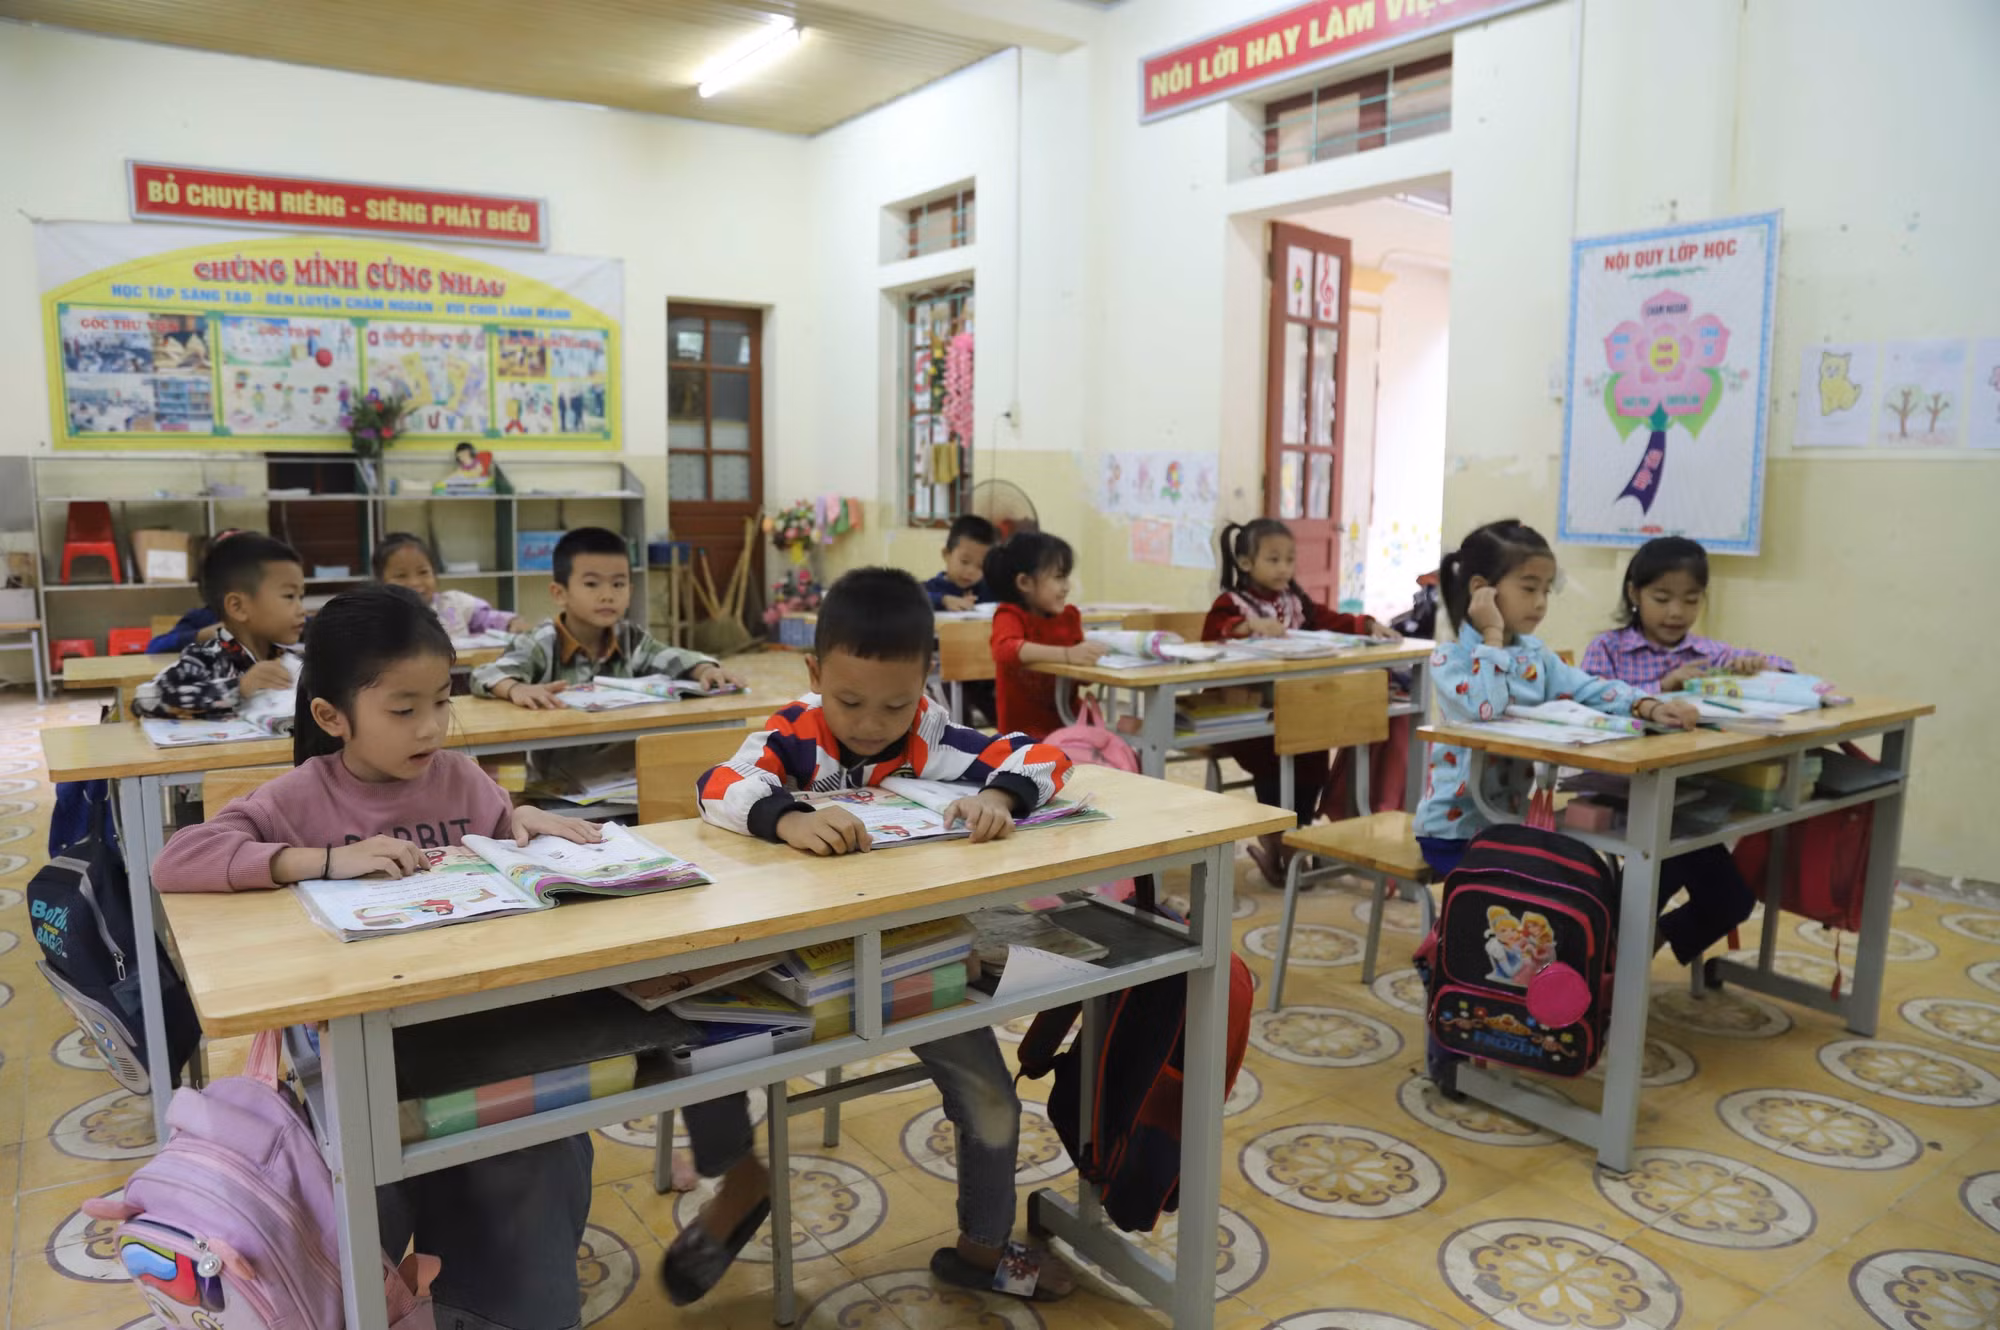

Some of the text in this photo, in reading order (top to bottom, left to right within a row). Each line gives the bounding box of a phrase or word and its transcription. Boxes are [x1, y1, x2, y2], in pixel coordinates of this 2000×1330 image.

[1150, 0, 1456, 99] NÓI LỜI HAY LÀM VI
[147, 173, 179, 204] BỎ
[185, 181, 276, 216] CHUYỆN
[280, 191, 347, 217] RIÊNG
[365, 198, 428, 225] SIÊNG
[431, 203, 483, 229] PHÁT
[486, 205, 531, 233] BIỂU
[193, 252, 507, 298] CHÚNG MÌNH CÙNG NHAU
[1603, 239, 1738, 271] NỘI QUY LỚP HỌC
[111, 283, 142, 300] HỌC
